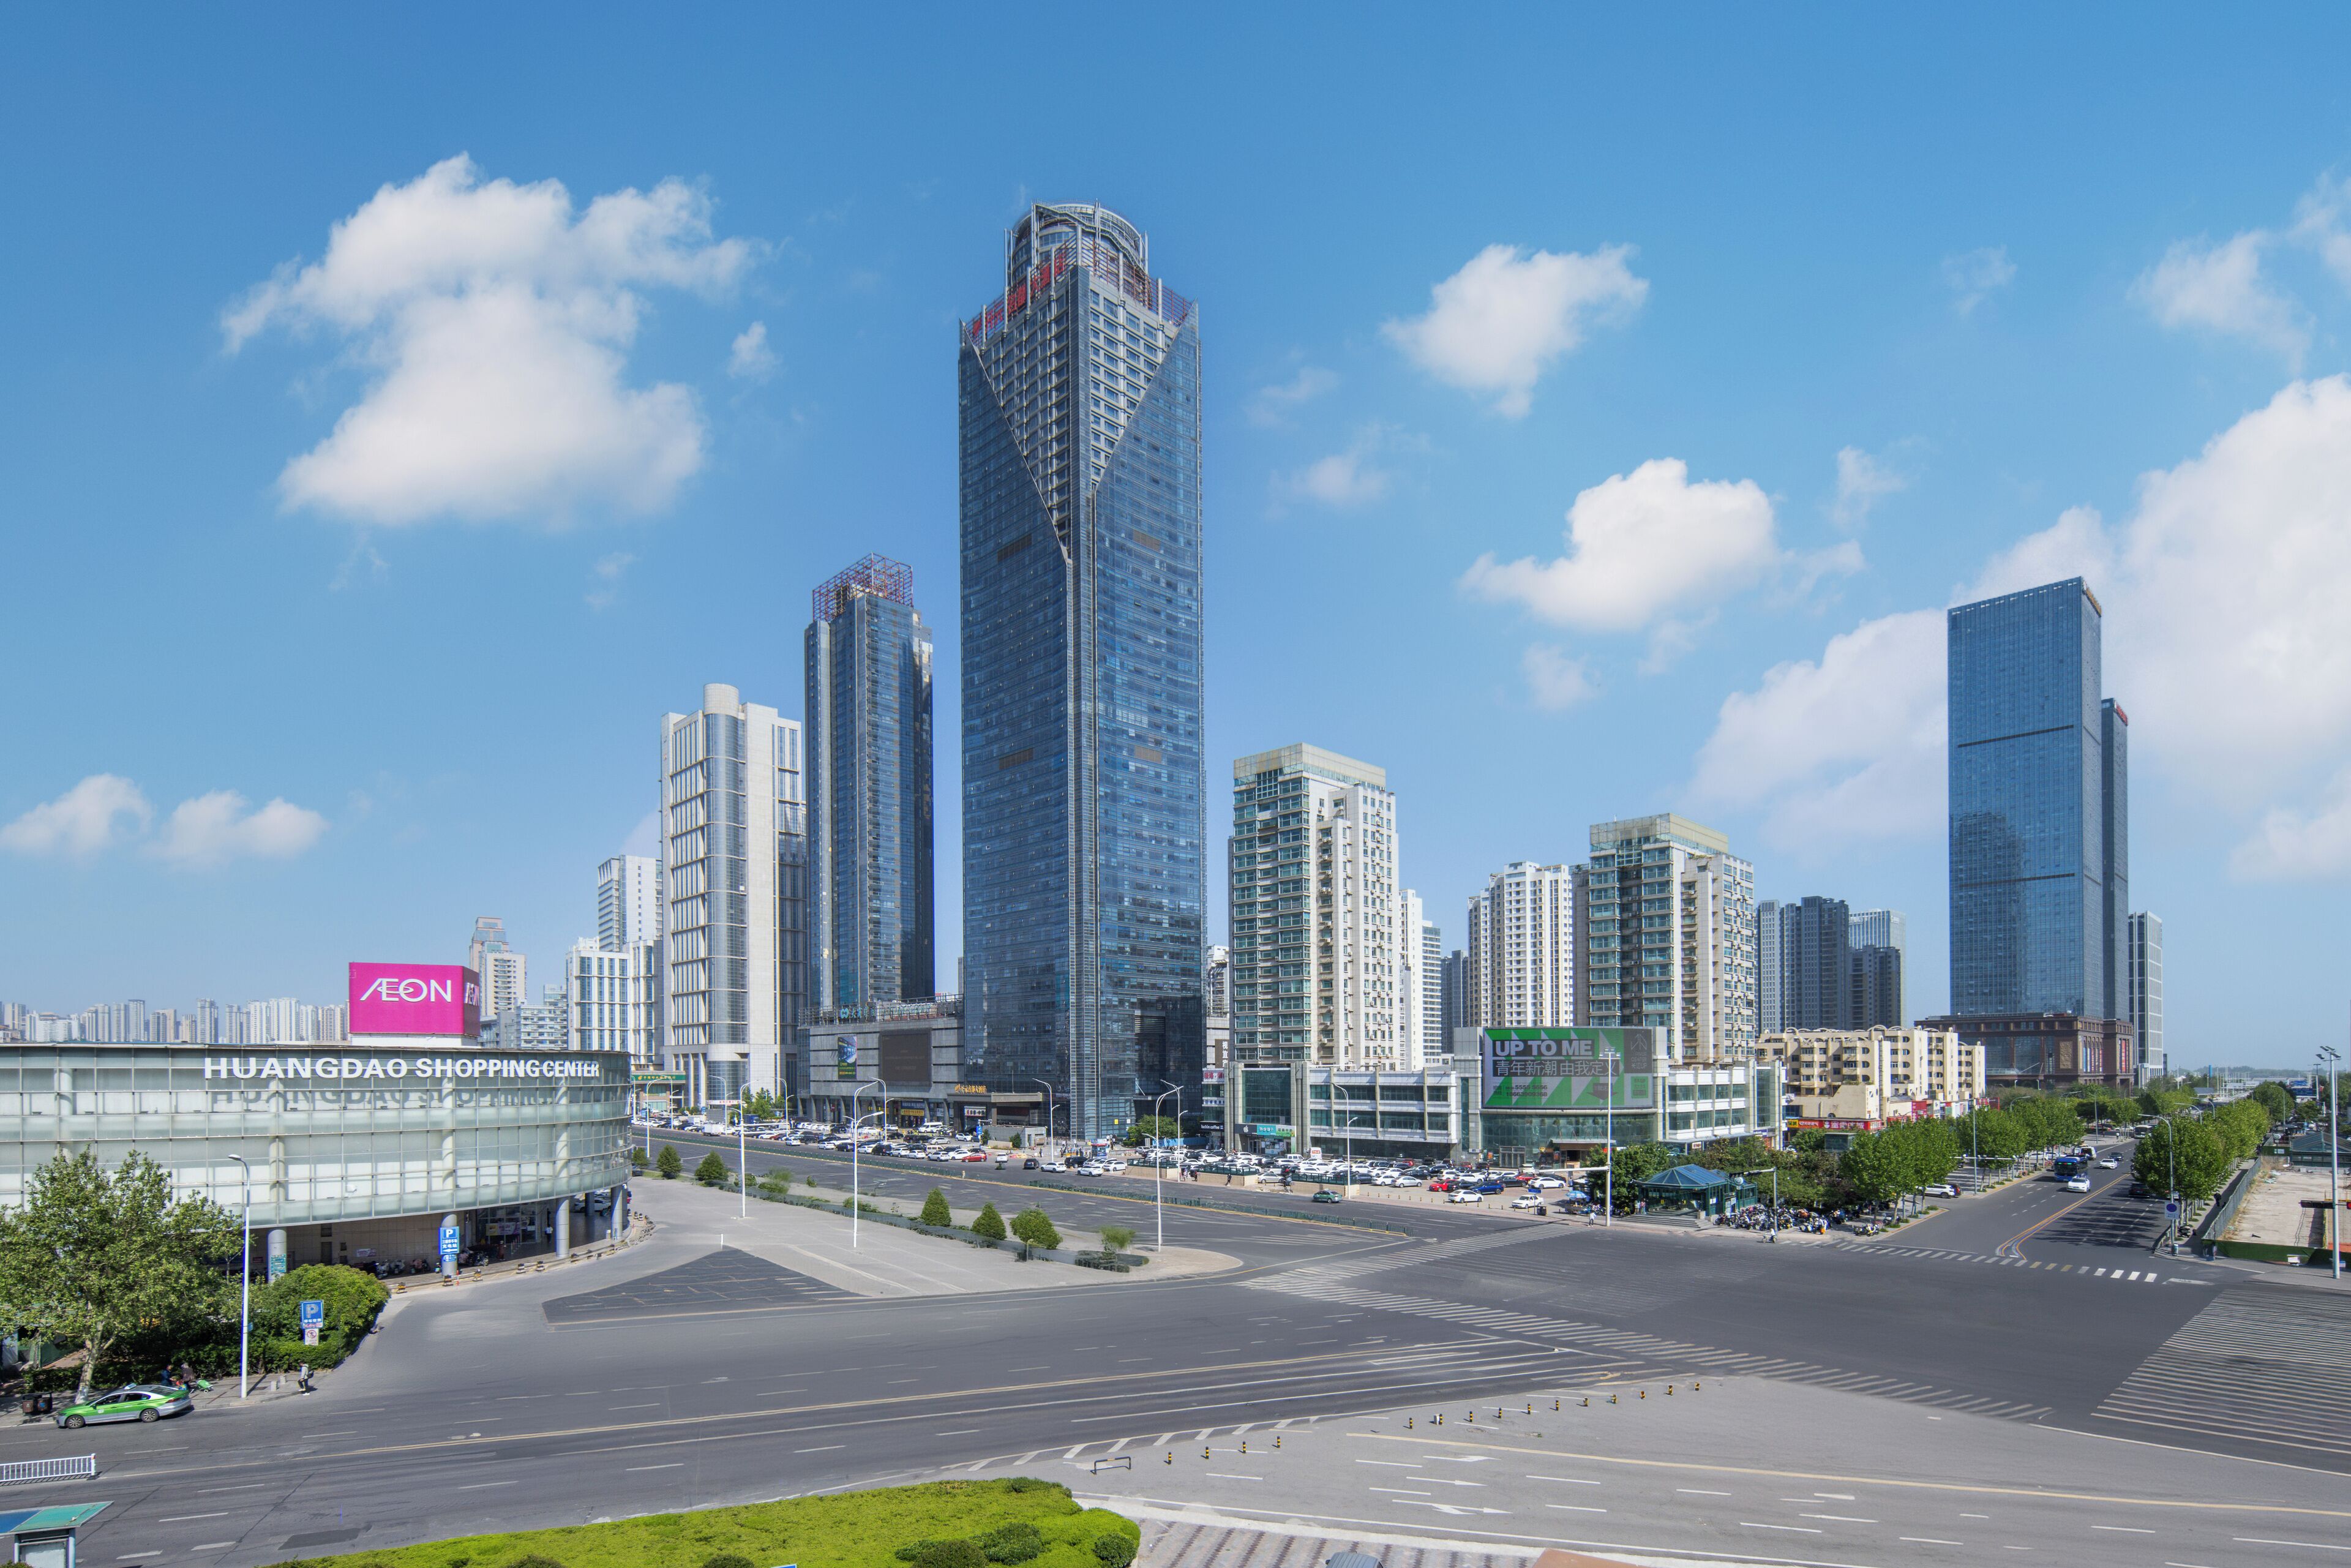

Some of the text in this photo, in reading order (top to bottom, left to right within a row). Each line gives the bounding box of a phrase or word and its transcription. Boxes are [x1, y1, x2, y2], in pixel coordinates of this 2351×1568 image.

[1496, 1041, 1592, 1056] UP TO ME
[204, 1057, 599, 1079] HUANGDAO SHOPPING CENTER
[1496, 1060, 1617, 1076] 青年新潮 由我定义
[446, 1229, 454, 1238] P
[306, 1304, 319, 1318] P
